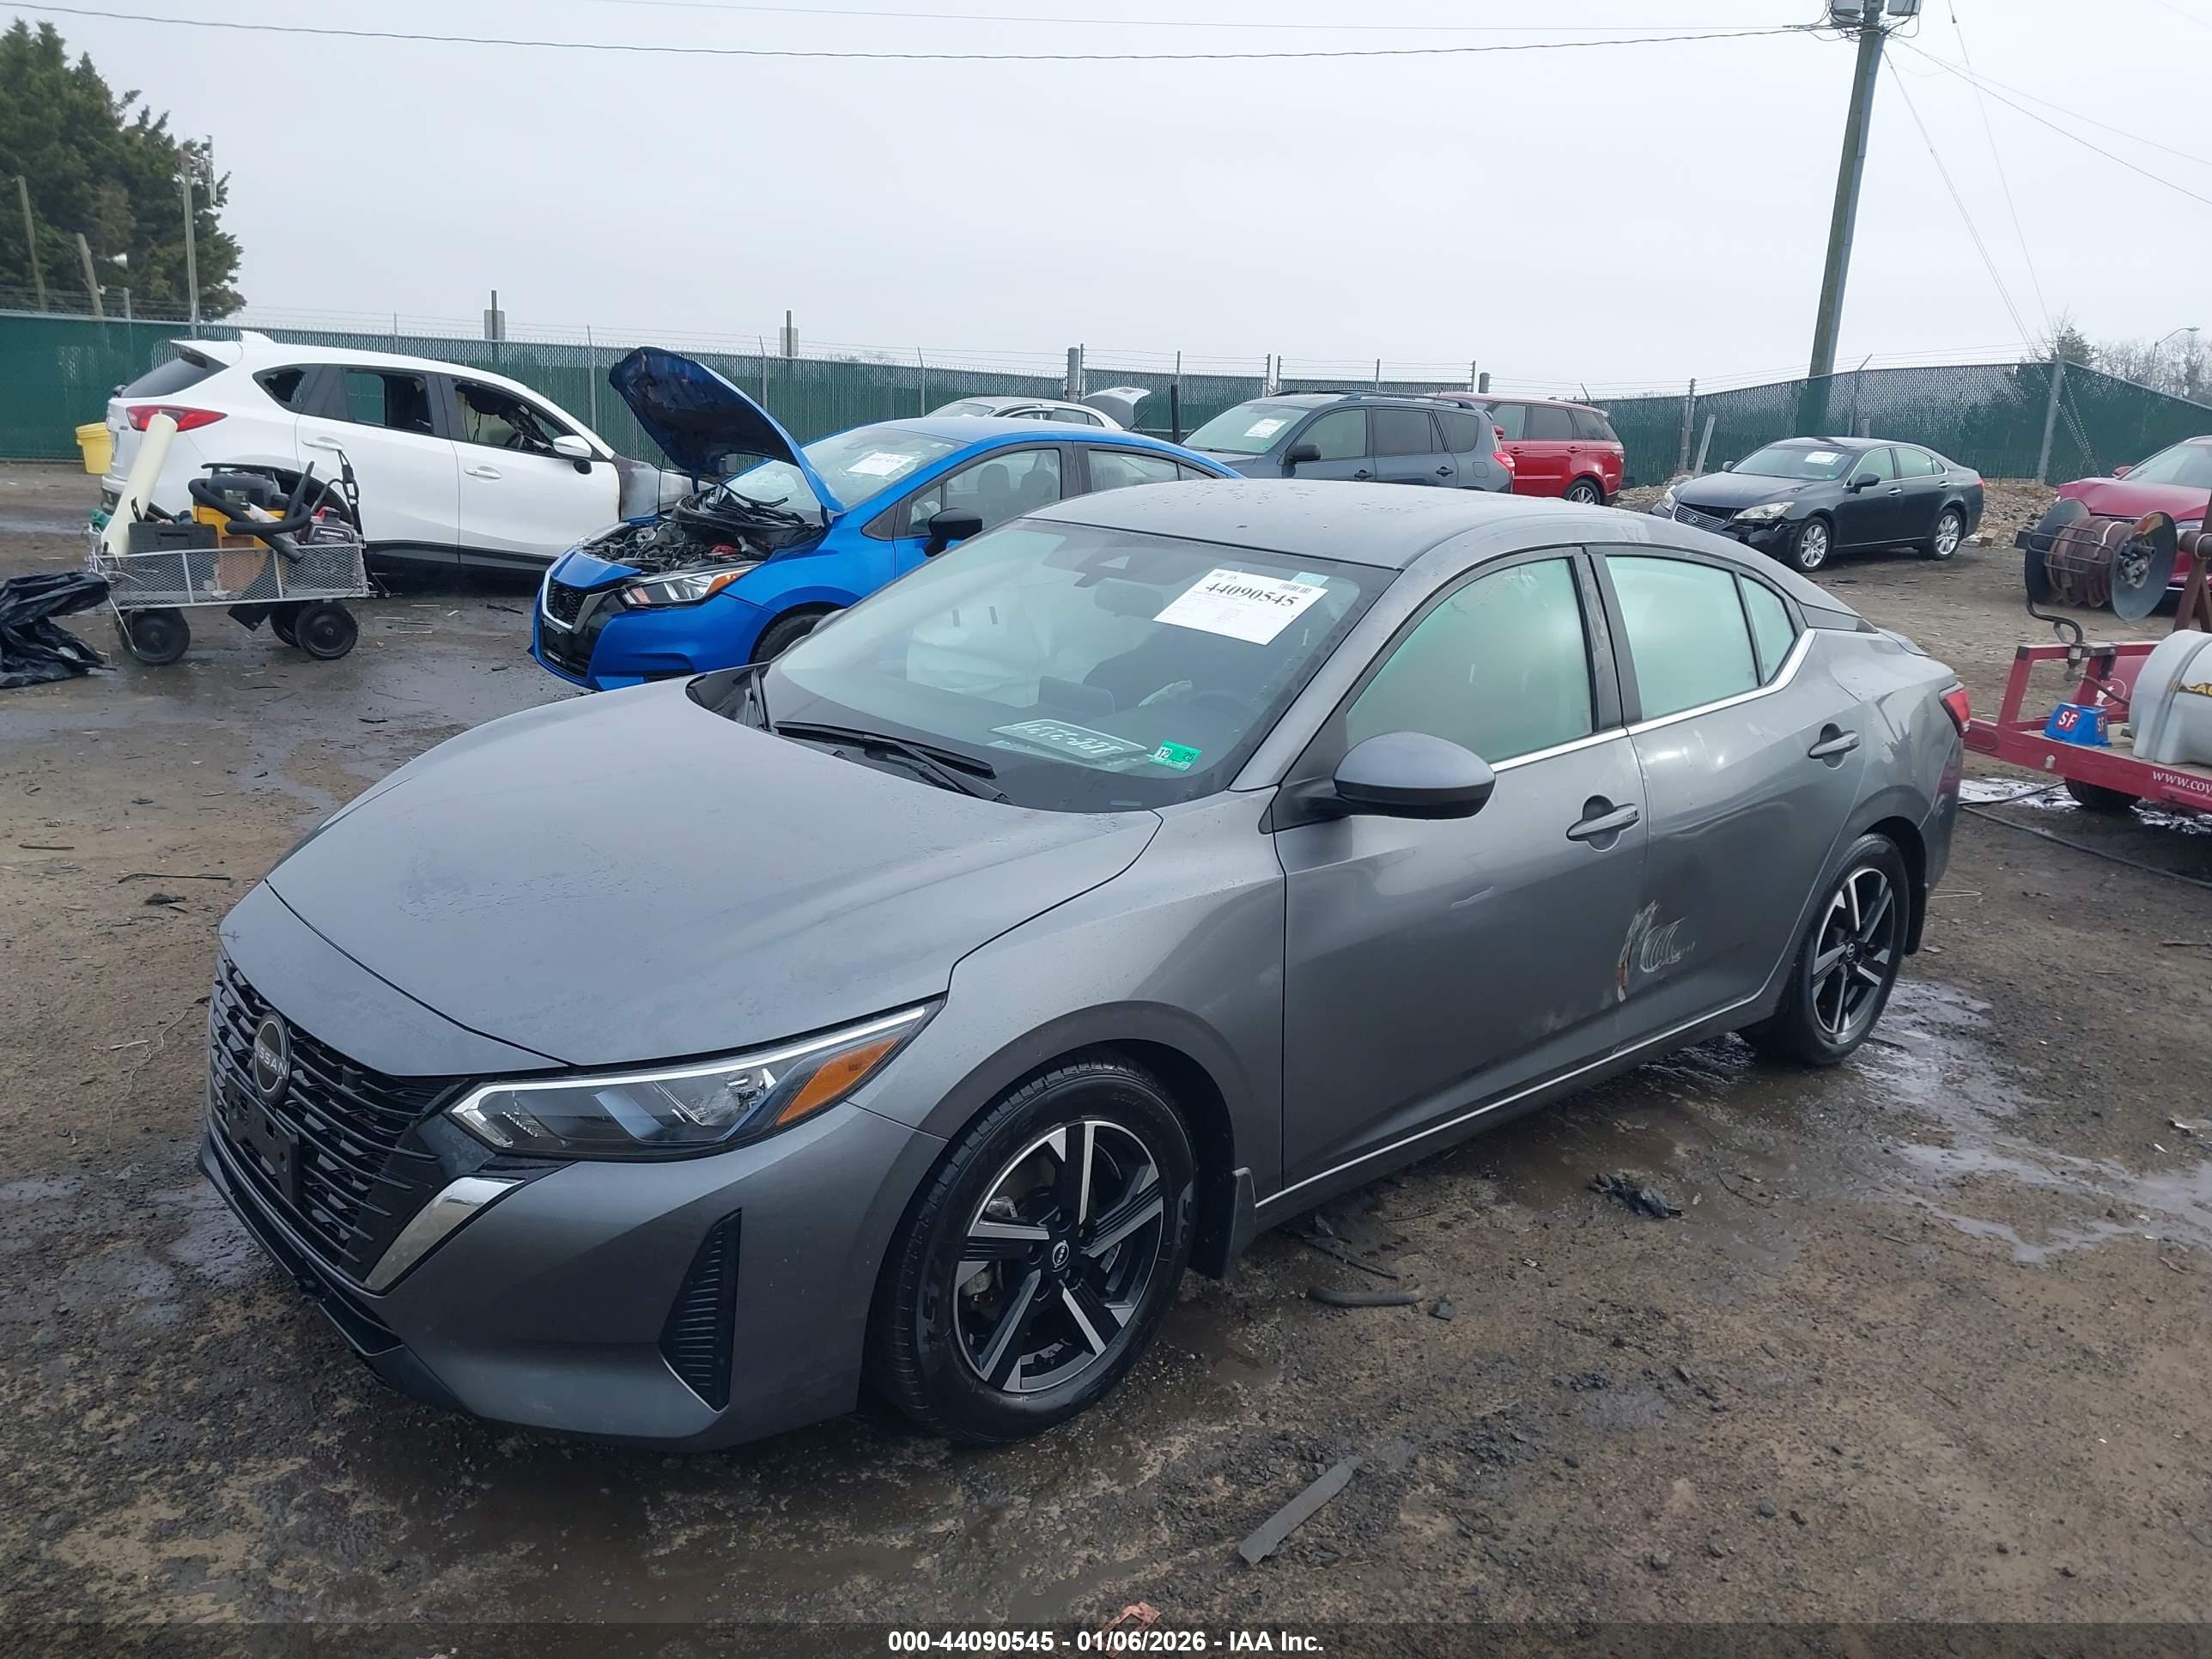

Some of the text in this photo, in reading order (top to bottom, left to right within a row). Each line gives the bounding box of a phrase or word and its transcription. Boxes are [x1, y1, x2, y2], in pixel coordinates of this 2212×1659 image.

[1206, 582, 1299, 607] 44090545
[2058, 711, 2078, 728] SF
[1158, 748, 1171, 759] 12
[256, 1042, 288, 1076] SSAN
